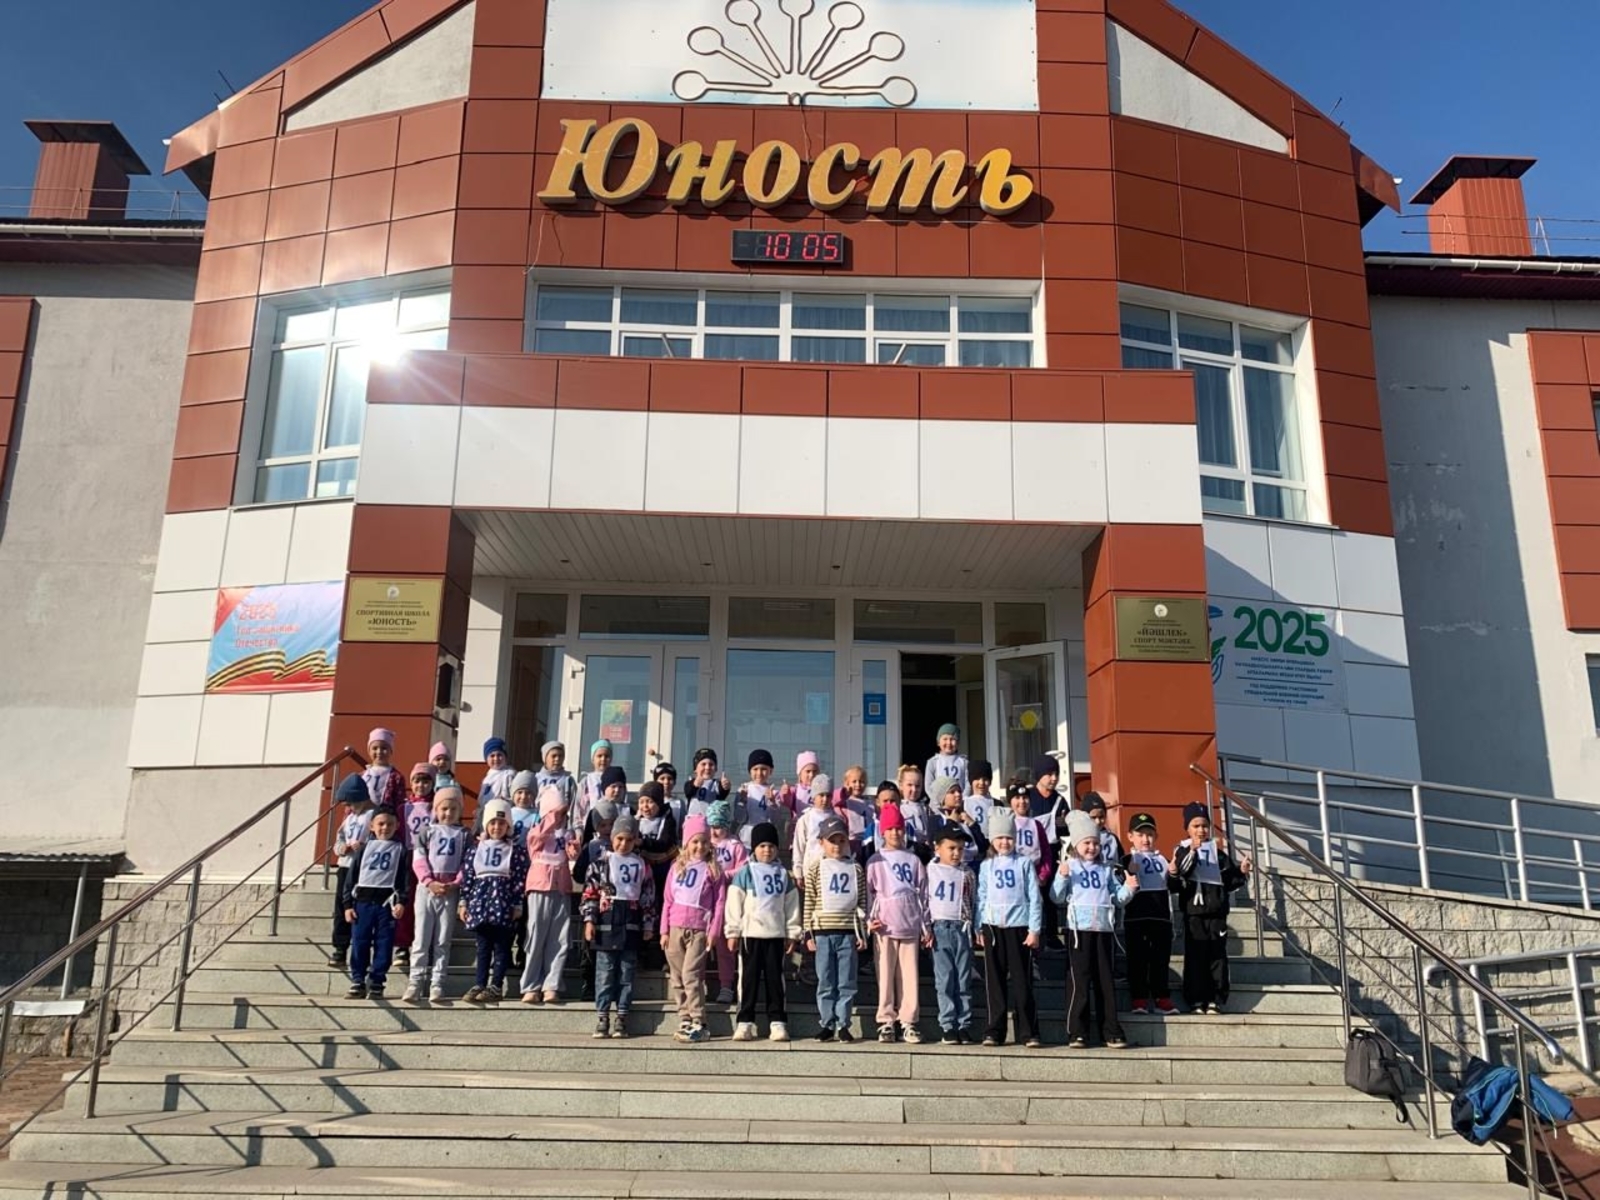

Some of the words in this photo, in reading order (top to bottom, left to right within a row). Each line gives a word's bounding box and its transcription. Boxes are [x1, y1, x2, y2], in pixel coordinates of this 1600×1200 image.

[536, 117, 1034, 216] Юность
[765, 233, 791, 260] 10
[802, 234, 838, 260] 05
[355, 609, 403, 617] СПОРТИВНАЯ
[404, 610, 431, 618] ШКОЛА
[1233, 606, 1330, 657] 2025
[369, 852, 391, 870] 28
[485, 847, 502, 867] 15
[620, 863, 640, 884] 37
[676, 868, 698, 888] 40
[892, 863, 913, 883] 36
[995, 869, 1015, 889] 39
[1080, 871, 1101, 889] 38
[763, 874, 784, 894] 35
[829, 873, 850, 894] 42
[935, 880, 955, 901] 41
